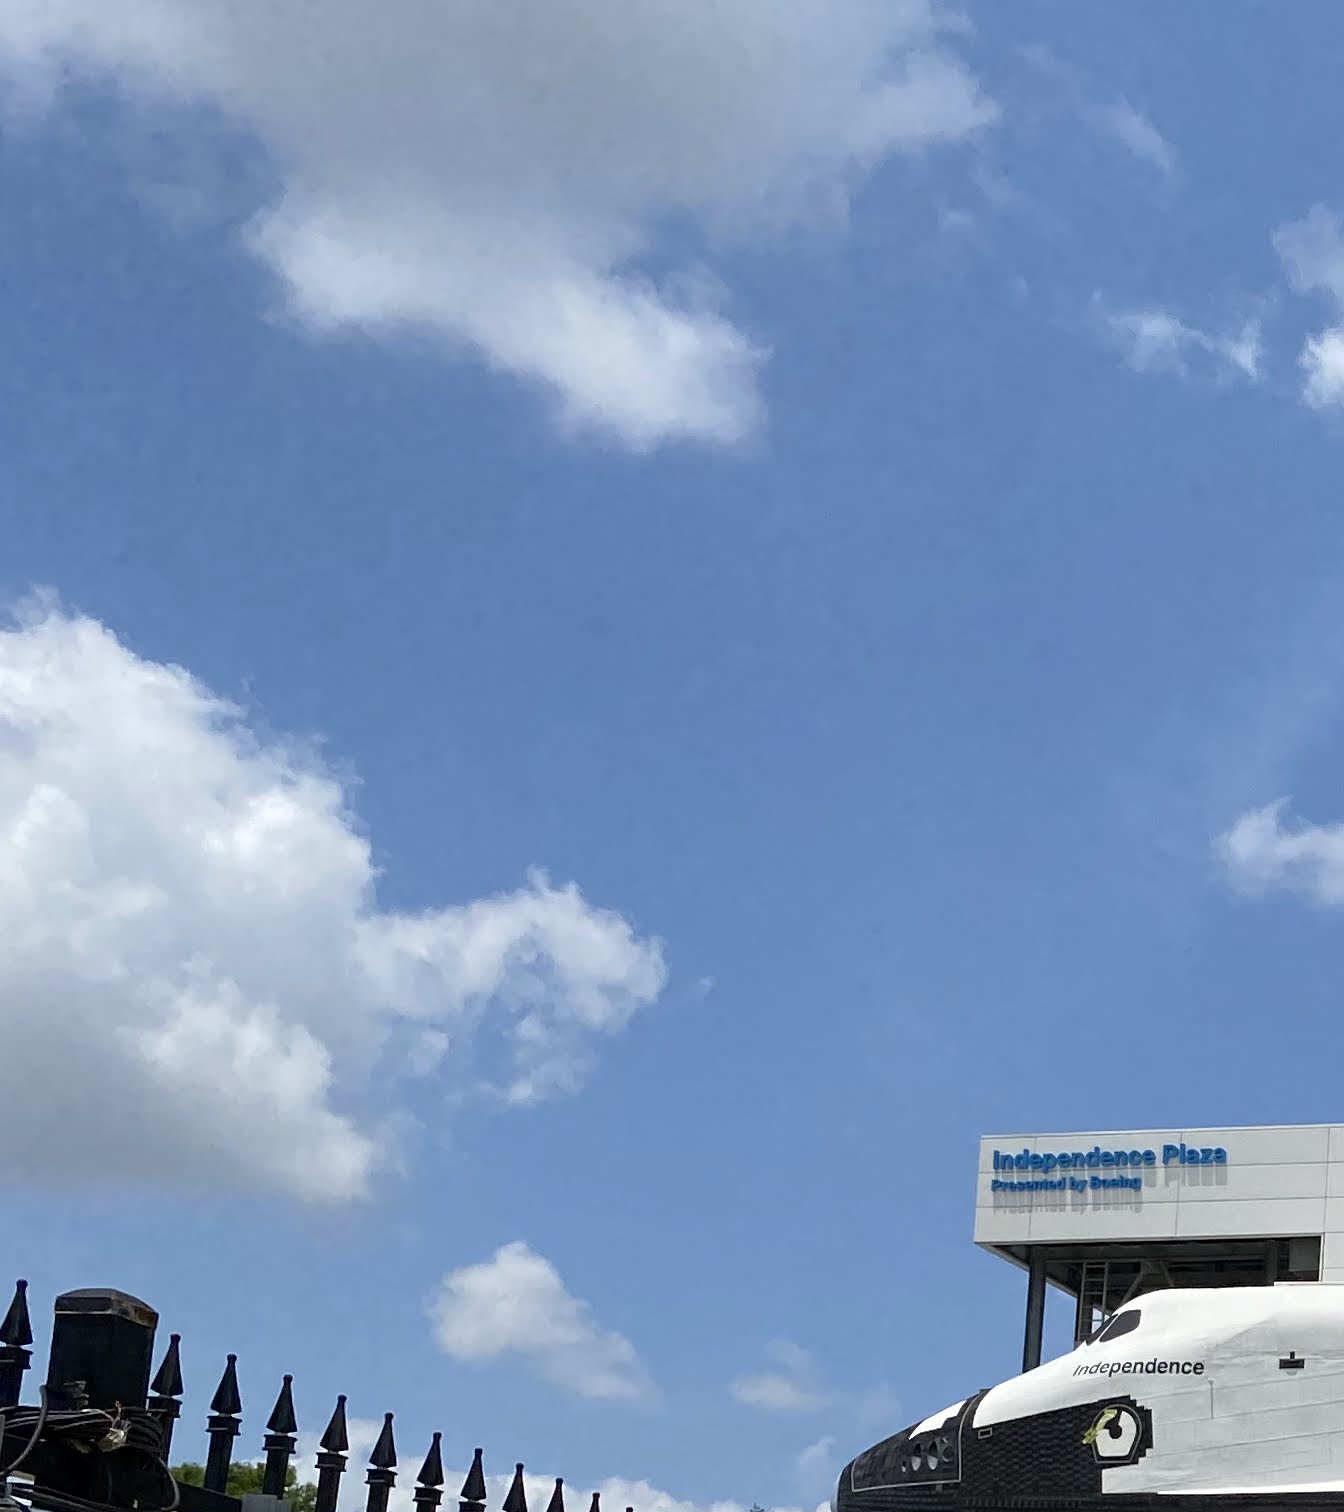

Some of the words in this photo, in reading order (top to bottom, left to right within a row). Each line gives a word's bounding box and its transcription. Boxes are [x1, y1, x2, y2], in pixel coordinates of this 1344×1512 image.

[993, 1146, 1156, 1173] Independence
[1162, 1143, 1228, 1165] Plaza
[1069, 1176, 1088, 1193] by
[1090, 1175, 1142, 1192] Boeing
[1073, 1357, 1204, 1378] Independence
